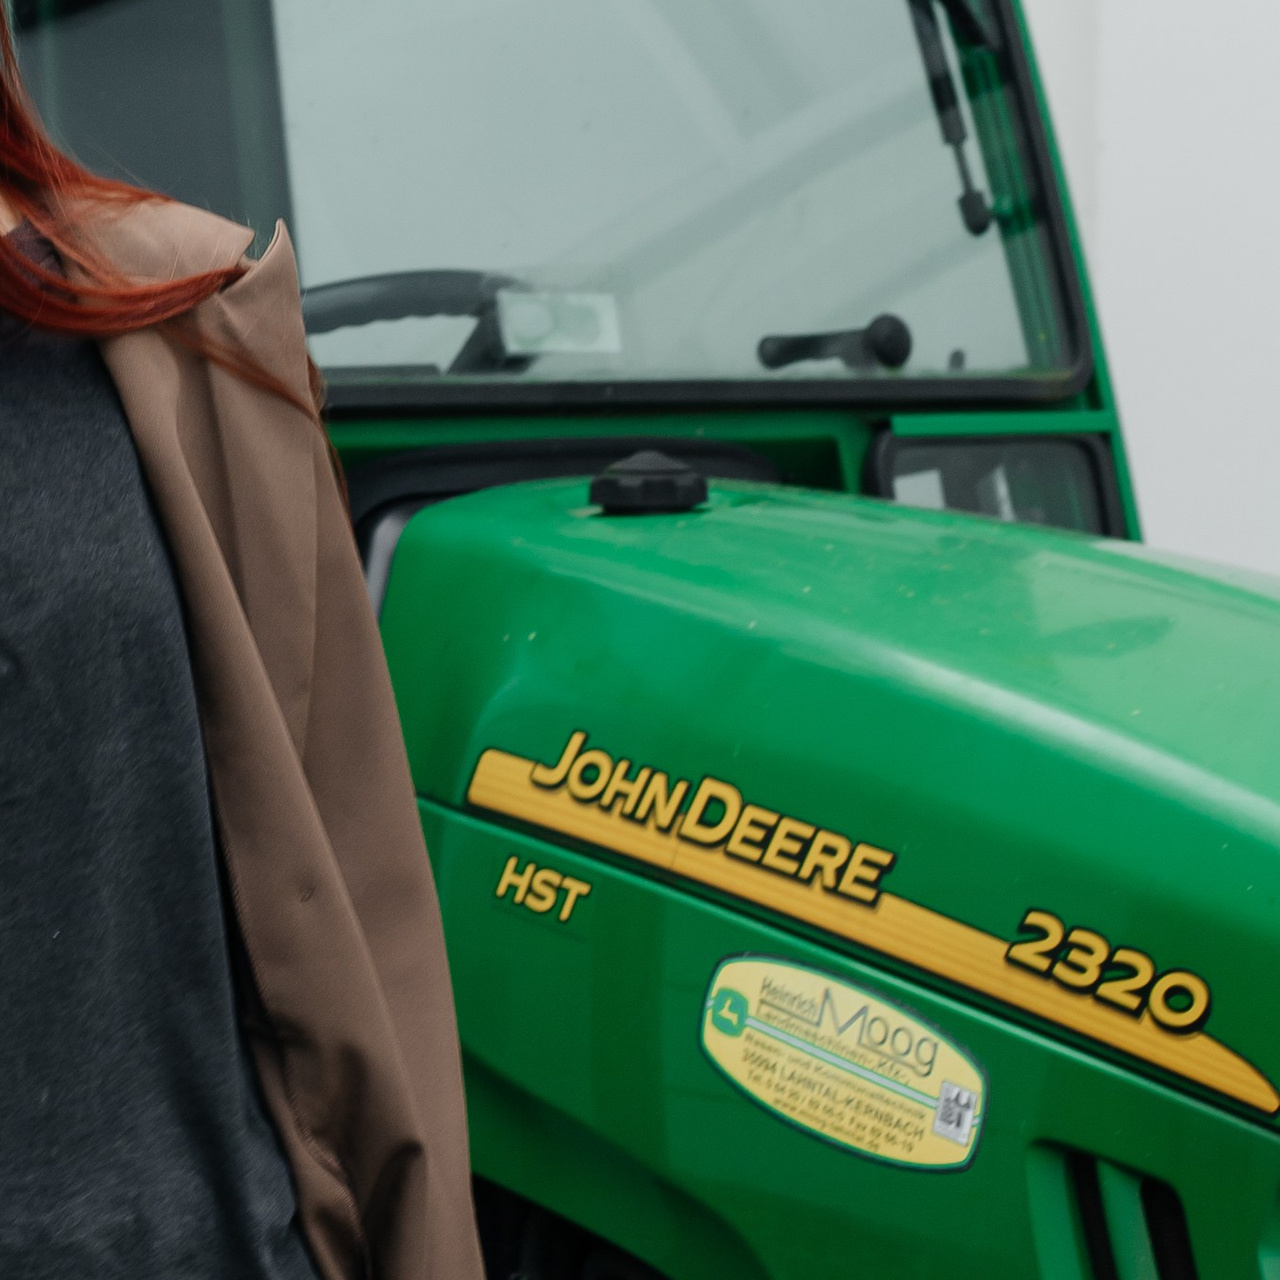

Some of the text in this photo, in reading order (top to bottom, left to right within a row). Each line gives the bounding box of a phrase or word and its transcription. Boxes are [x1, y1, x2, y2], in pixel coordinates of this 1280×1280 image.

[530, 730, 895, 906] JOHN DEERE
[494, 855, 592, 922] HST
[1007, 910, 1208, 1030] 2320
[761, 977, 937, 1077] Heinrich Moog
